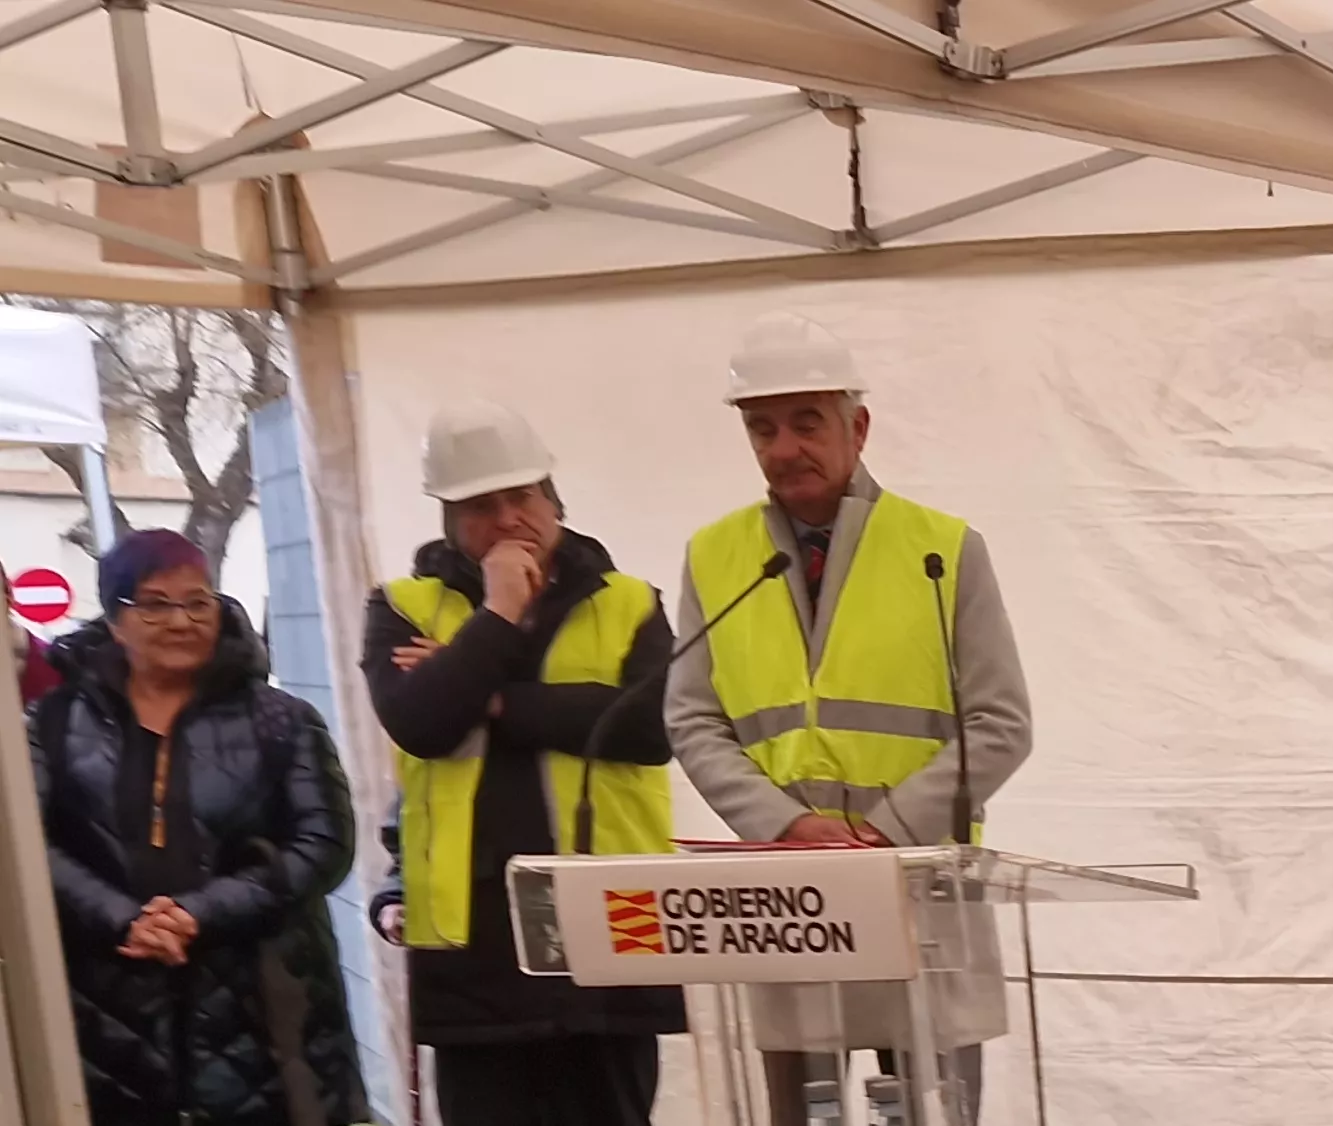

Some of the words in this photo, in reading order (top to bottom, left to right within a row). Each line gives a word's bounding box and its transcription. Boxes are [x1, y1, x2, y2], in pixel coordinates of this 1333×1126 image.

[661, 885, 825, 920] GOBIERNO
[664, 922, 710, 955] DE
[717, 920, 857, 955] ARAGON
